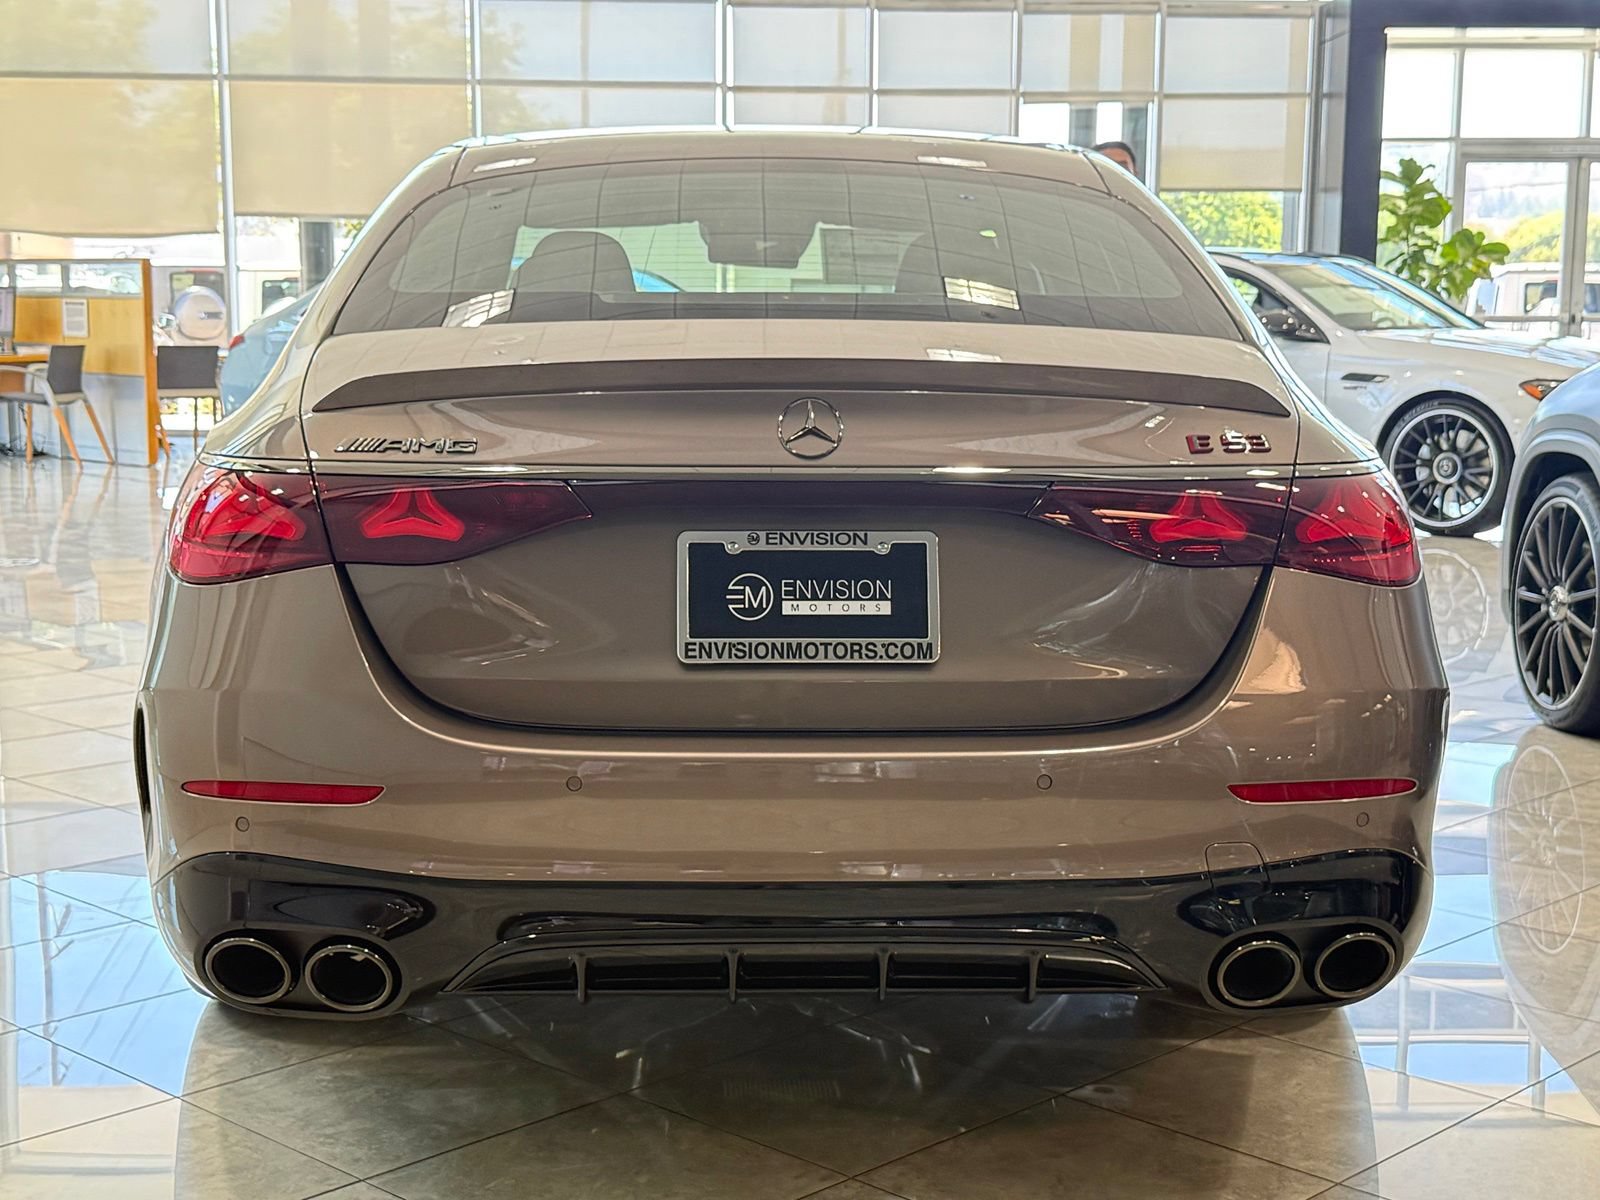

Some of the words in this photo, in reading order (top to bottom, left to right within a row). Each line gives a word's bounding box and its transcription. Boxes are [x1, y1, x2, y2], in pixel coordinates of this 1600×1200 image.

[376, 437, 478, 453] AMG
[765, 532, 868, 546] ENVISION
[781, 579, 892, 599] ENVISION
[790, 602, 882, 613] MOTORS
[684, 641, 934, 660] ENVISIONMOTORS.COM
